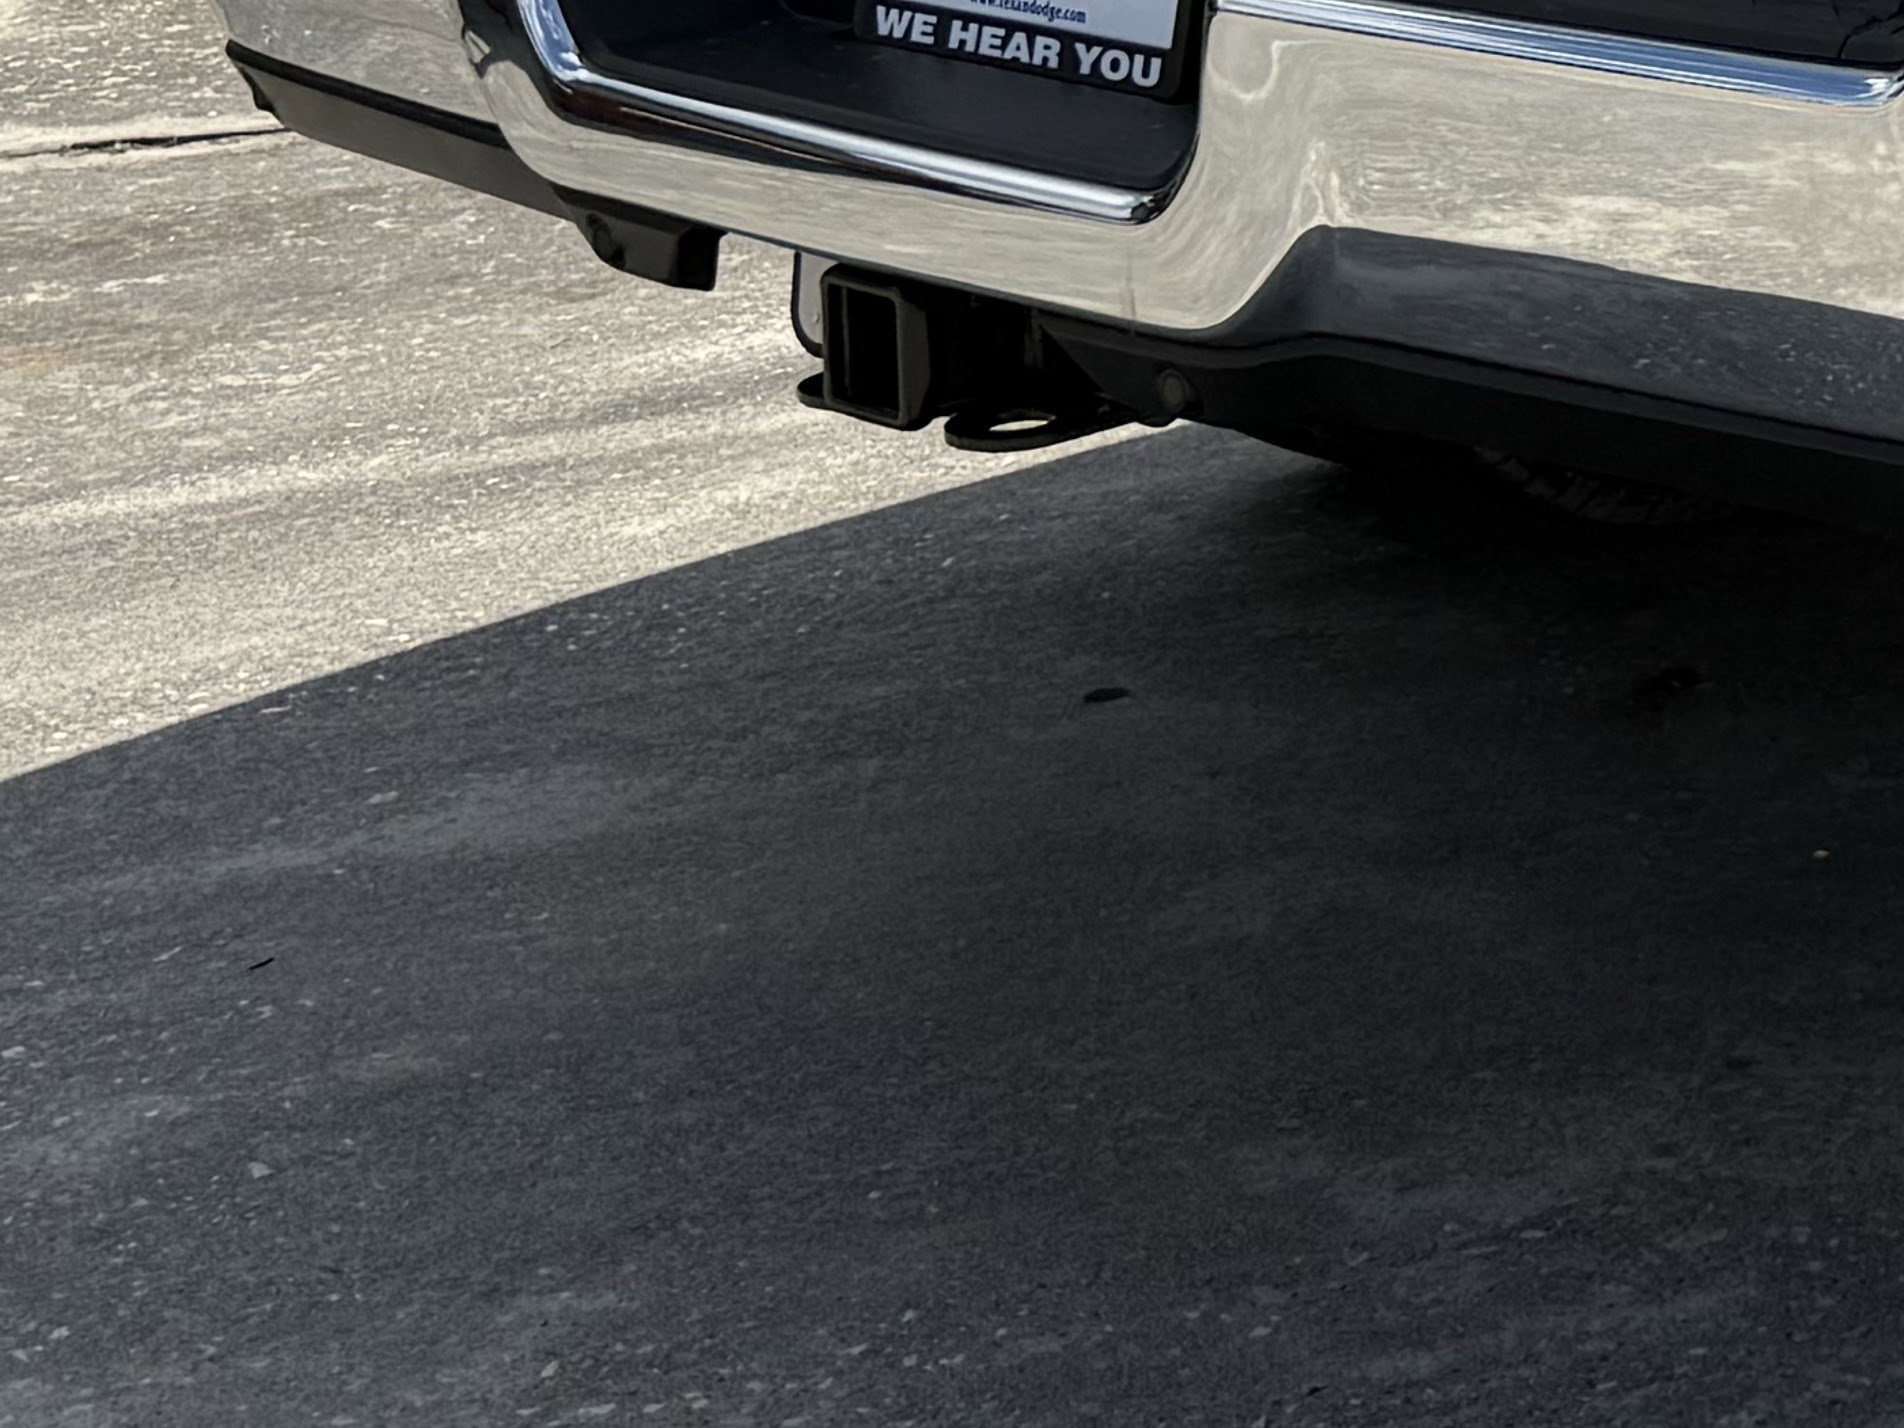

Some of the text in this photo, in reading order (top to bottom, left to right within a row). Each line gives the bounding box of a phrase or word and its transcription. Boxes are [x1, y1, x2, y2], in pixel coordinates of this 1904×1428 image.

[876, 4, 1163, 89] WE HEAR YOU
